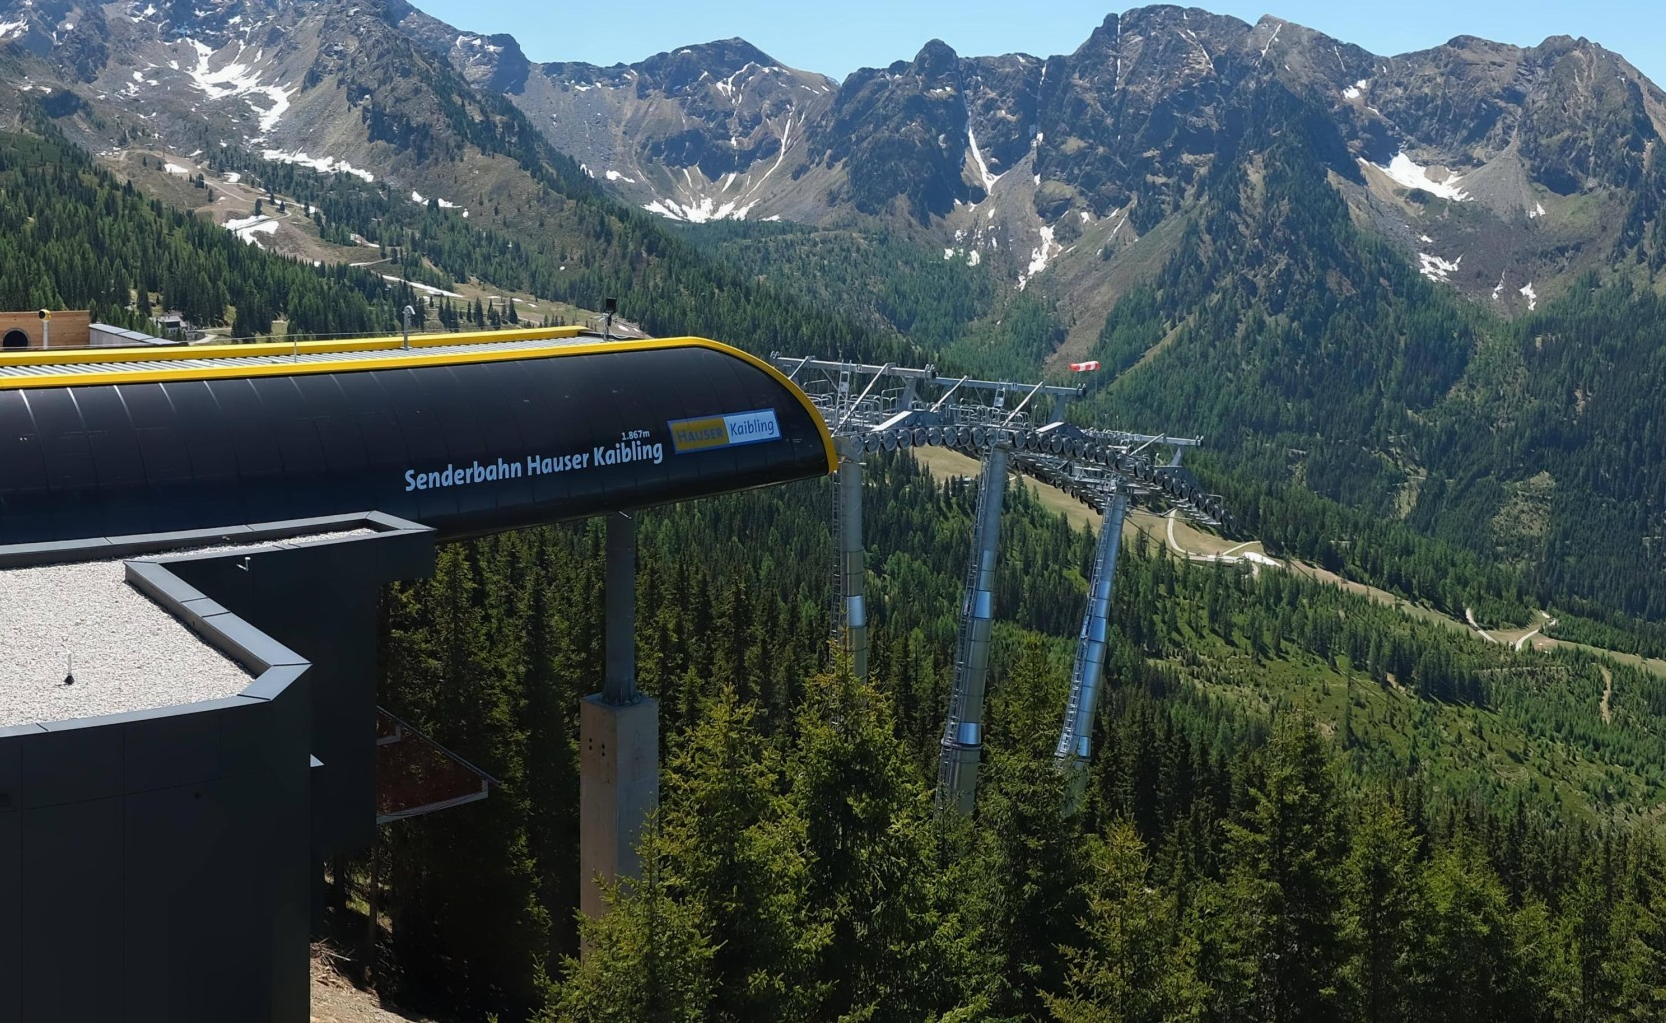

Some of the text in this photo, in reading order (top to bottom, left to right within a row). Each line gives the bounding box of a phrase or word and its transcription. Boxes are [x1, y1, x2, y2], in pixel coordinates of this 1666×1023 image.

[621, 429, 650, 441] 1.867m
[676, 419, 774, 444] HAUSER Kaibling
[404, 441, 663, 492] Senderbahn Hauser Kaibling
